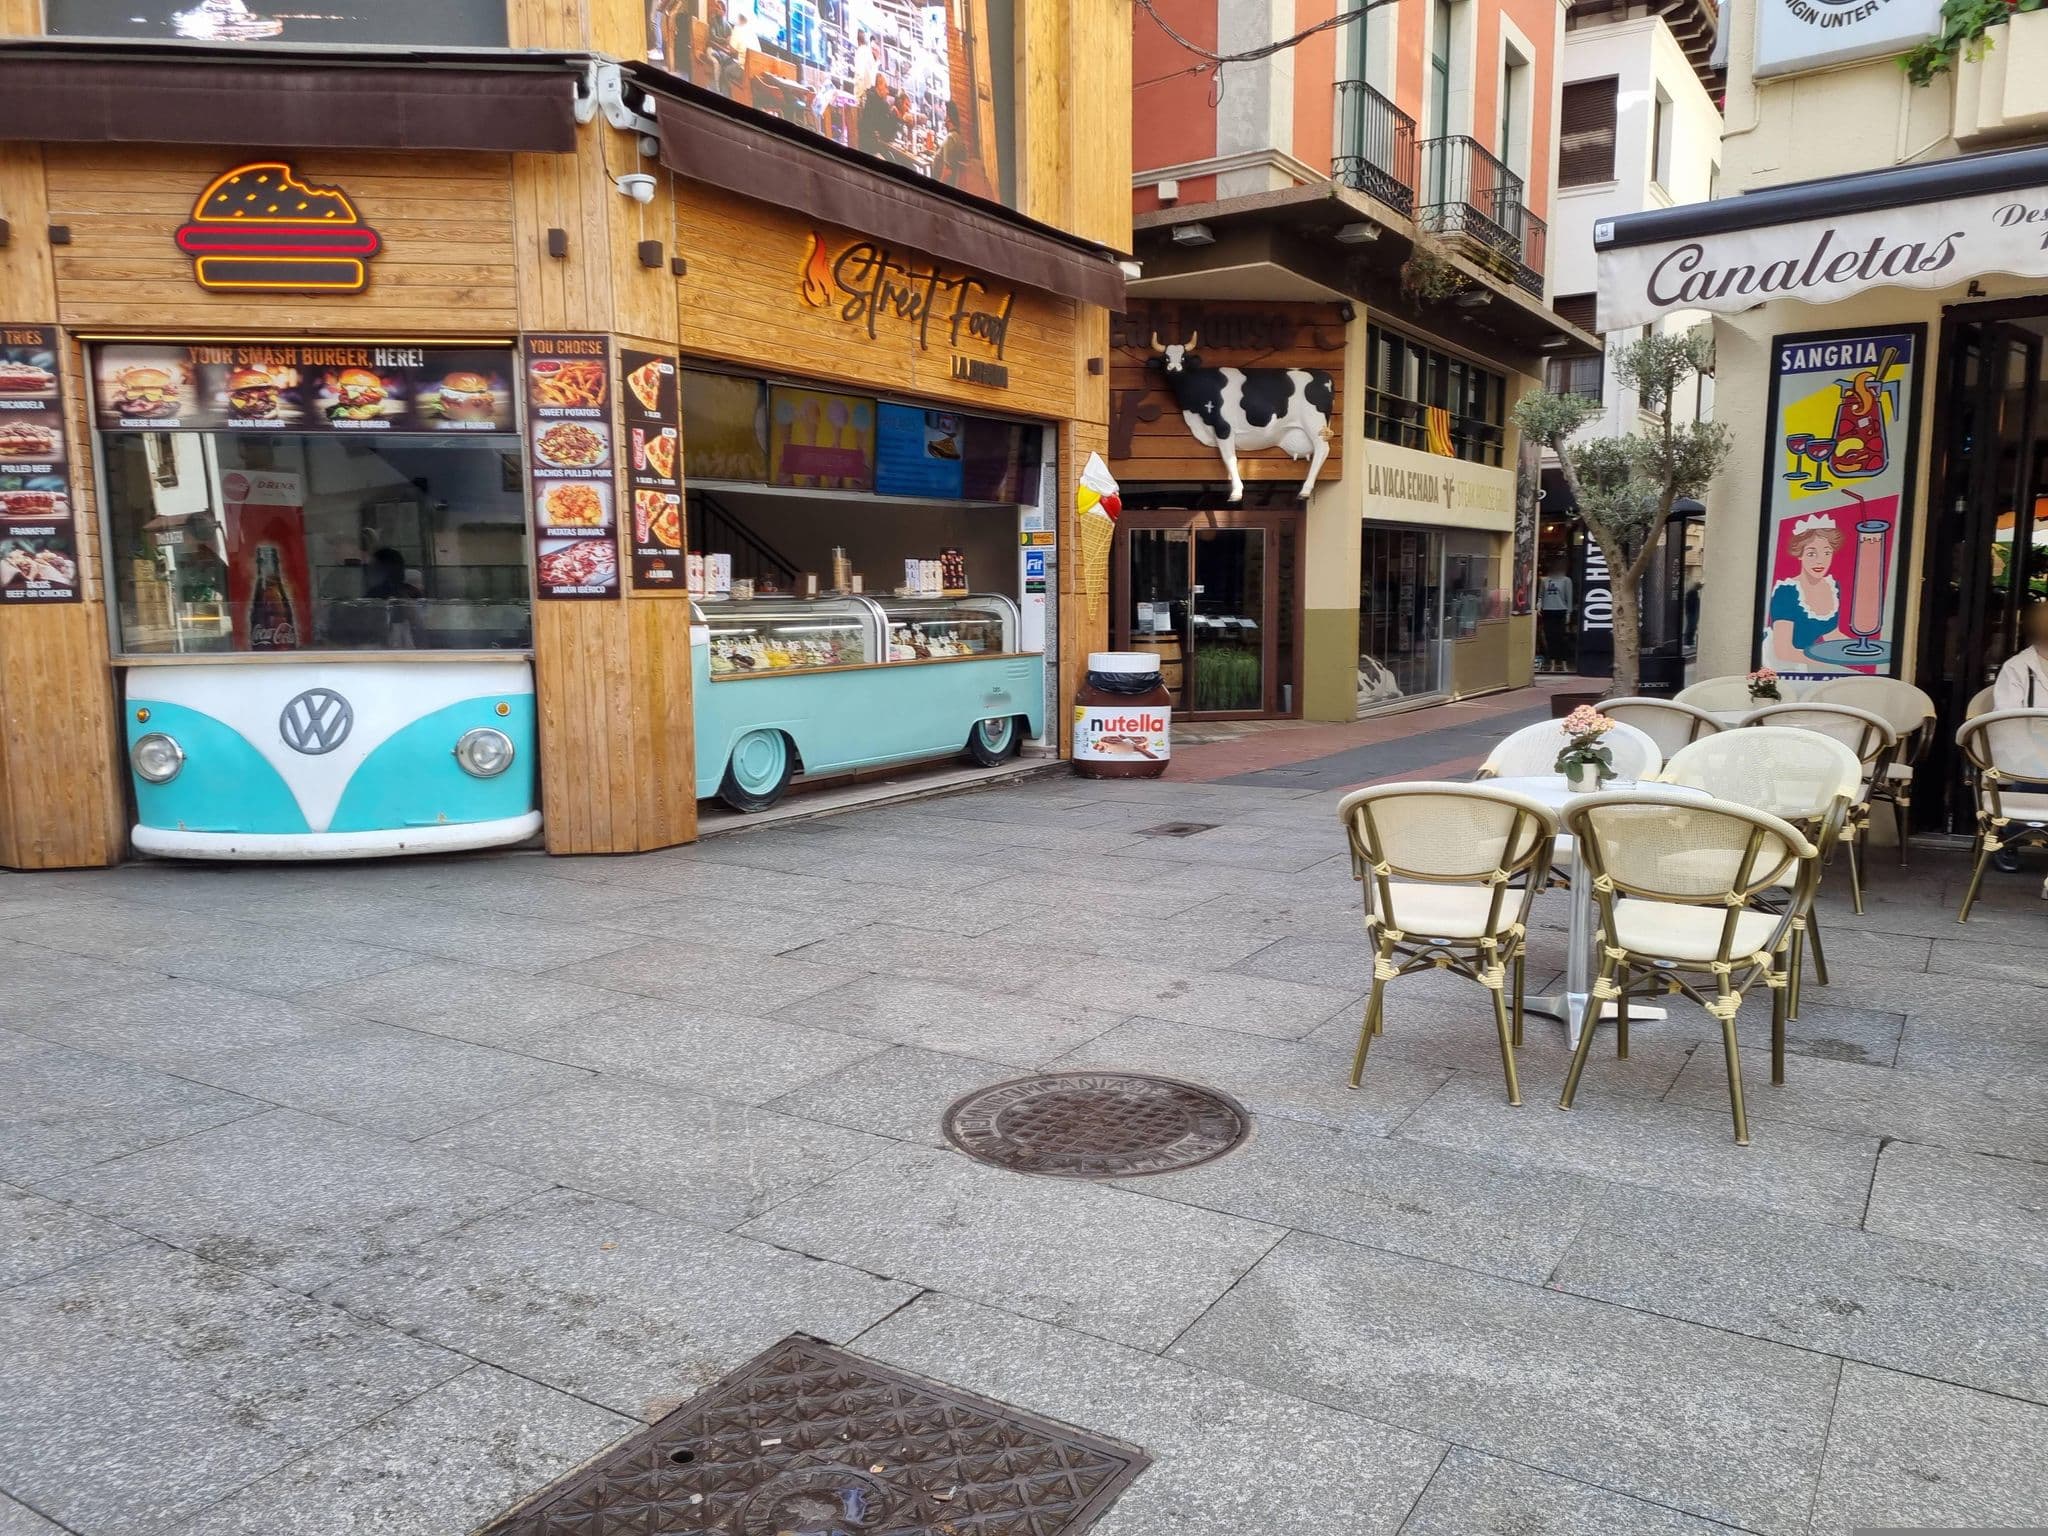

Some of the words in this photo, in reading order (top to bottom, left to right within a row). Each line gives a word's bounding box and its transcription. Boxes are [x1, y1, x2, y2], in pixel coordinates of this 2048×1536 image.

[1785, 0, 1820, 26] IGIN
[1819, 0, 1880, 29] UNTER
[1646, 228, 1966, 307] Canaletas
[833, 241, 954, 351] Street
[947, 276, 1016, 361] Food
[190, 346, 234, 365] YOUR
[238, 347, 297, 366] SMASH
[375, 348, 424, 368] HERE!
[530, 339, 554, 355] YOU
[555, 340, 604, 355] CHOOSE
[1780, 341, 1878, 371] SANGRIA
[539, 408, 564, 418] SWEET
[565, 408, 602, 418] POTATOES
[533, 469, 563, 478] NACHOS
[564, 469, 592, 478] PULLED
[1368, 463, 1381, 495] LA
[1382, 466, 1406, 500] VACA
[1407, 470, 1440, 504] ECHADA
[577, 528, 606, 537] BRAVAS
[1027, 558, 1044, 571] Fit
[1090, 713, 1165, 732] nutella
